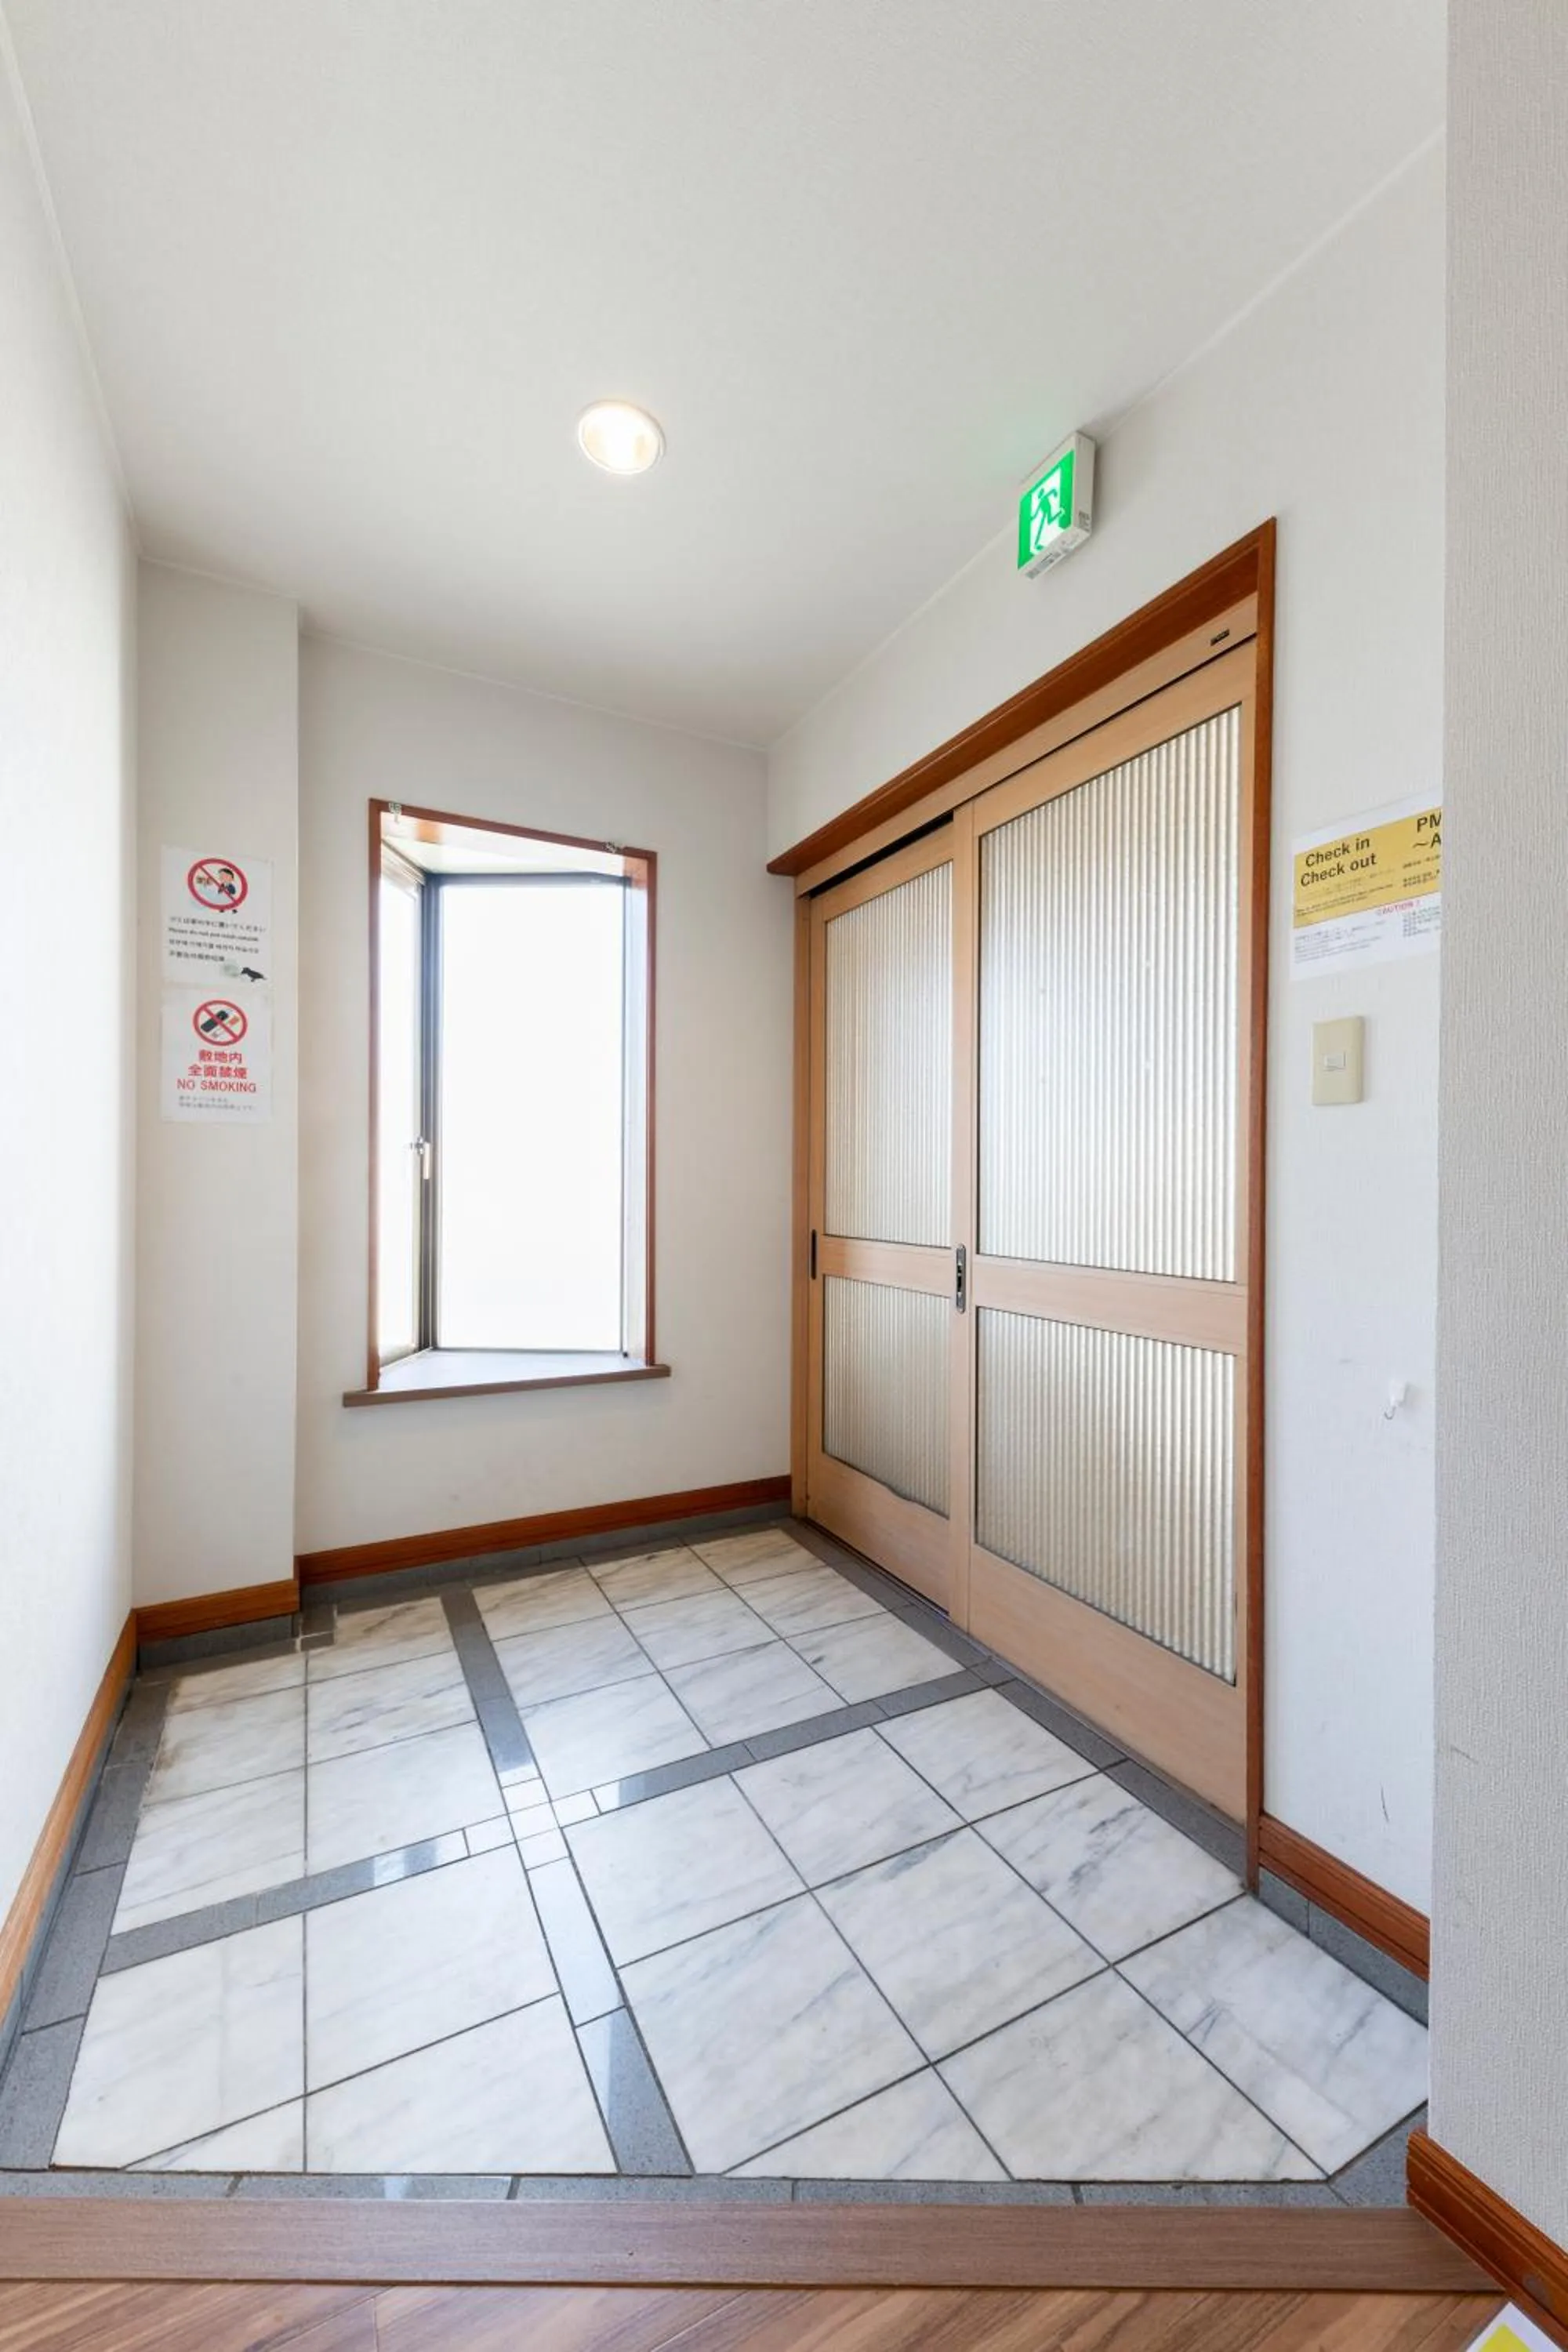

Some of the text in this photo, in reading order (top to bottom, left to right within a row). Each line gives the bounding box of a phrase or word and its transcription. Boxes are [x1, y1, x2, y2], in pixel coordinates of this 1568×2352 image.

[1305, 837, 1370, 868] Check in
[1301, 862, 1345, 887] Check
[1350, 853, 1377, 871] out
[187, 1063, 248, 1080] 全面禁煙
[176, 1078, 256, 1093] NO SMOKING
